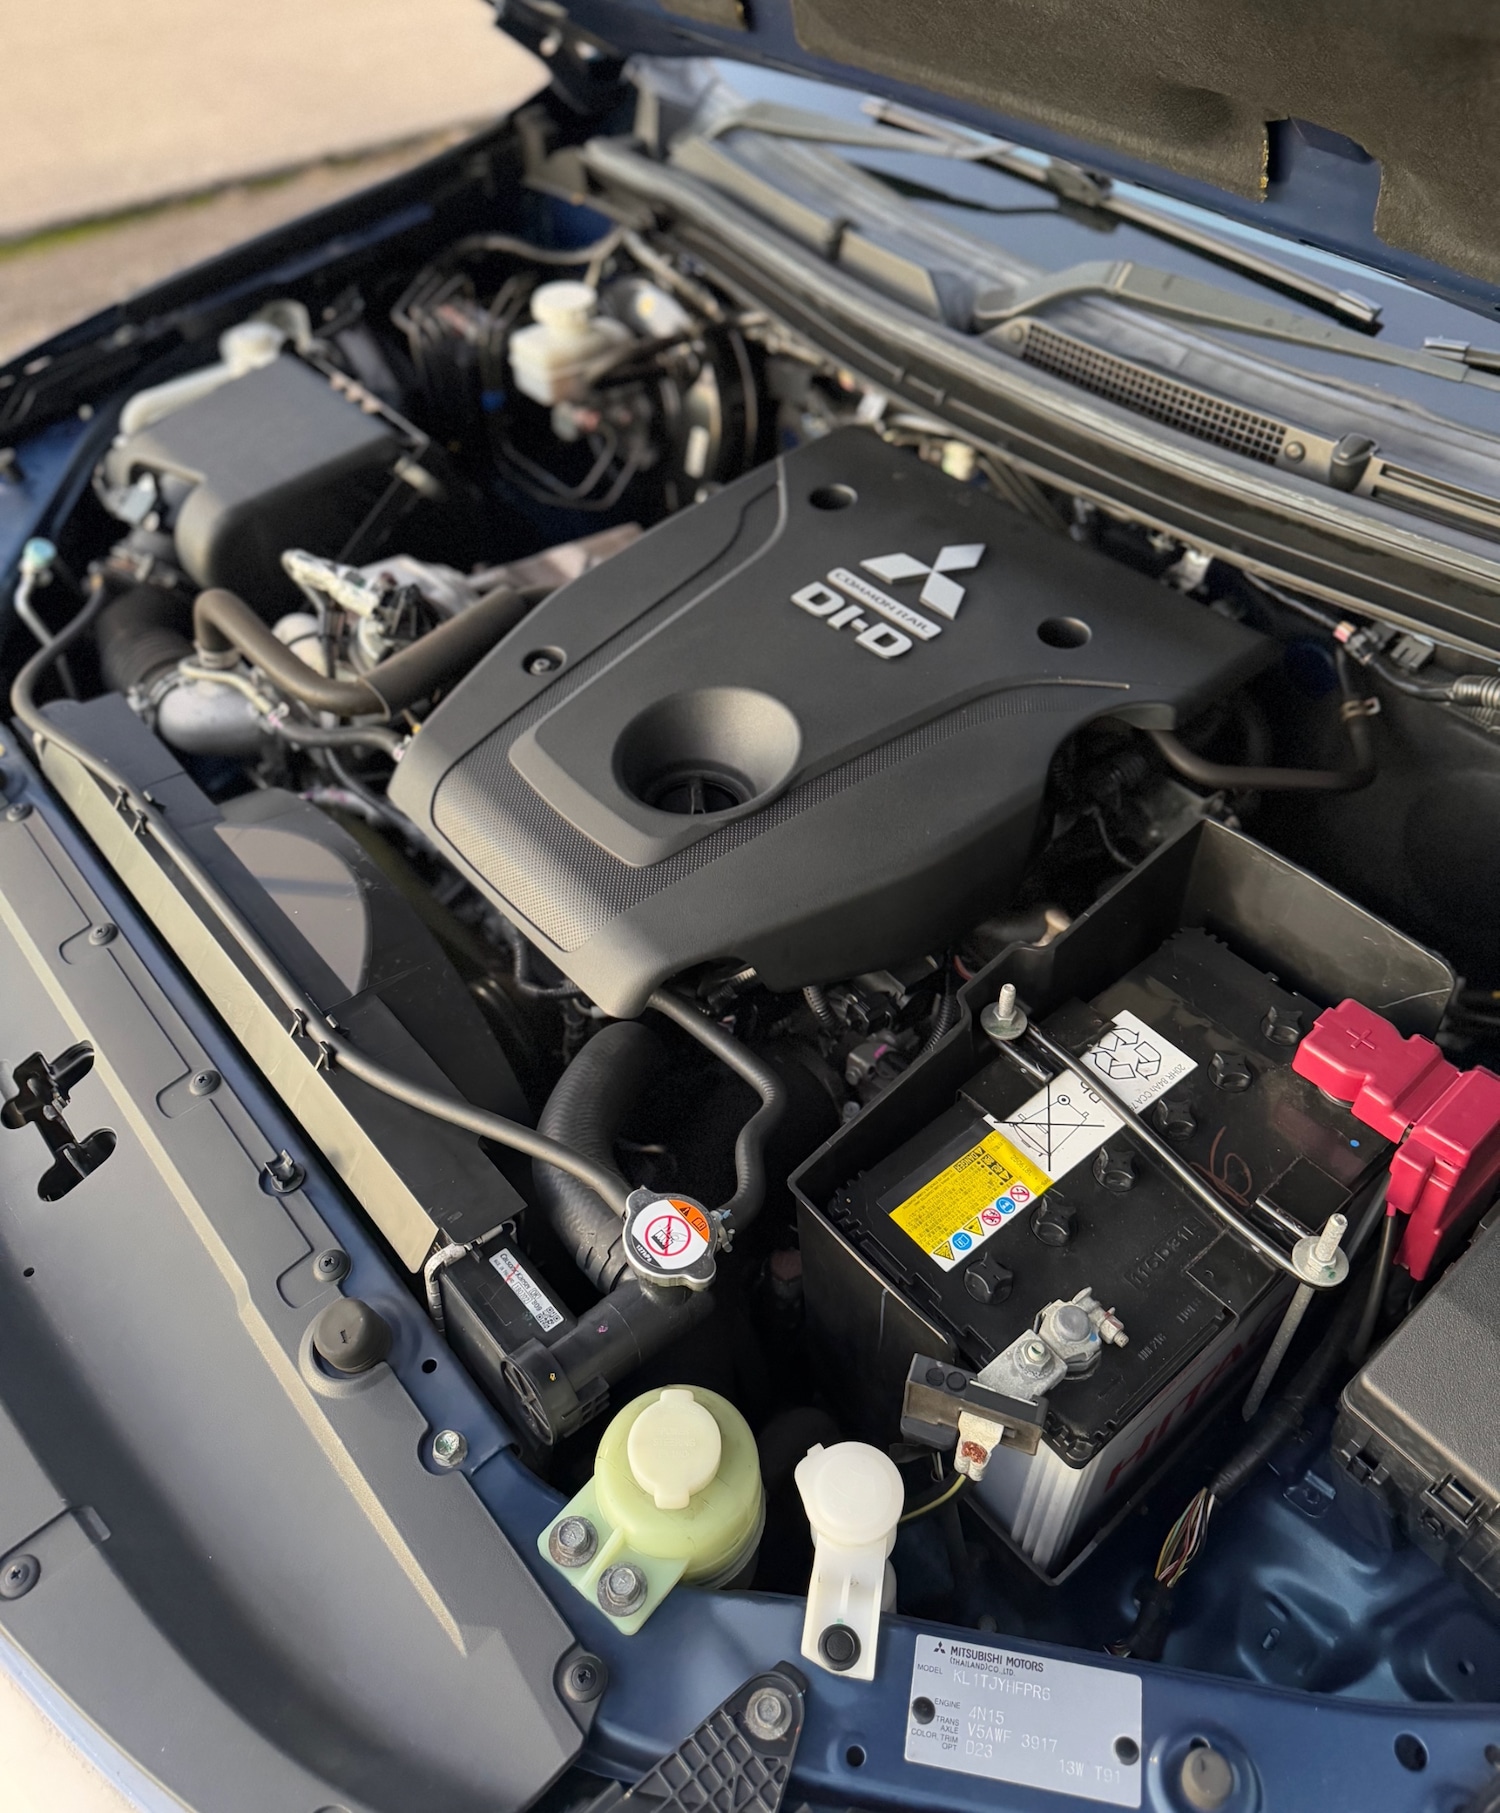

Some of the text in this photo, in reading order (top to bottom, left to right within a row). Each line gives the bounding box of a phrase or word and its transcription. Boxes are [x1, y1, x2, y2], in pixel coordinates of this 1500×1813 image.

[834, 571, 930, 634] COMMON RAIL
[790, 581, 913, 660] DI-D
[1134, 1090, 1153, 1105] CCA
[953, 1152, 979, 1172] DANGER
[917, 1663, 943, 1675] MODEL
[950, 1646, 1044, 1672] MITSUBISHI MOTORS
[934, 1698, 1005, 1725] ENGINE 4N15
[935, 1715, 960, 1726] TRANS
[940, 1725, 959, 1735] AXLE
[1021, 1734, 1058, 1753] 3917
[941, 1734, 959, 1743] TRIM
[941, 1742, 957, 1751] OPT
